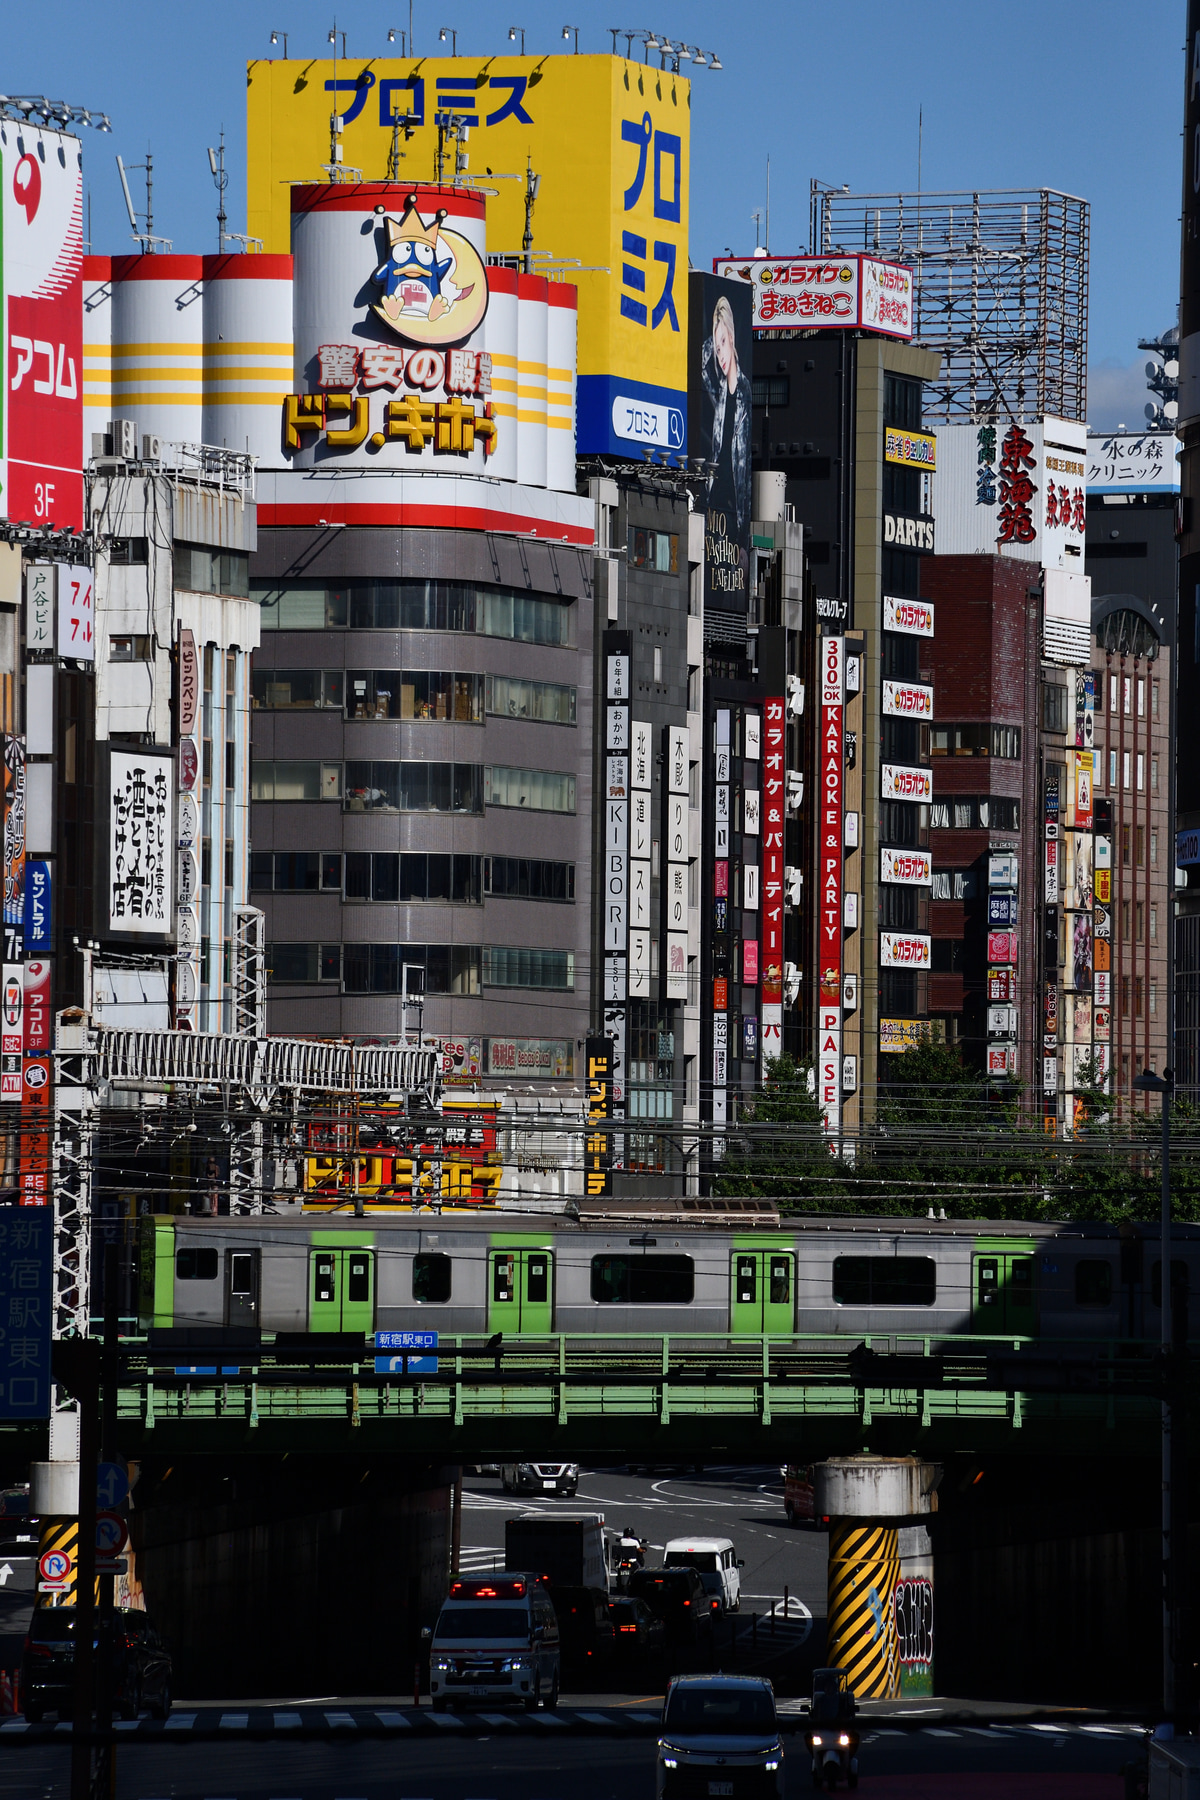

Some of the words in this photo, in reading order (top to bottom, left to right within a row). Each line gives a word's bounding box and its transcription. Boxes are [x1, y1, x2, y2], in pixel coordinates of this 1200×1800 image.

[324, 70, 535, 127] プロミス
[772, 264, 840, 285] カラオケ
[882, 271, 905, 293] カラオケ
[759, 287, 853, 322] まねきねこ
[877, 294, 909, 326] まねきねこ
[10, 335, 77, 400] アコム
[317, 345, 492, 395] 驚安の殿堂
[625, 407, 659, 439] プロミス
[1106, 439, 1163, 461] 水の森
[996, 424, 1038, 544] 東海苑
[1087, 463, 1163, 482] クリニック
[34, 484, 55, 517] 3F
[1045, 478, 1086, 534] 東海苑
[706, 507, 727, 537] MIO
[884, 515, 935, 549] DARTS
[705, 535, 740, 566] YASHIRO
[32, 573, 49, 641] 戸谷ビル
[900, 604, 927, 630] カラオケ
[614, 659, 622, 696] 6年4組
[827, 641, 838, 685] 300
[824, 684, 841, 692] People
[824, 691, 840, 701] OK
[900, 687, 926, 713] カラオケ
[613, 711, 622, 745] おかか
[825, 707, 839, 824] KARAOKE
[899, 771, 925, 796] カラオケ
[765, 703, 783, 948] カラオケ&パーティー
[825, 834, 837, 847] &
[610, 805, 623, 945] KIBORI
[898, 855, 924, 879] カラオケ
[32, 871, 45, 940] セントラル
[824, 859, 838, 941] PARTY
[897, 939, 924, 963] カラオケ
[30, 994, 43, 1035] アコム
[717, 1016, 727, 1045] ZEST
[4, 1036, 21, 1052] たばこ
[30, 1038, 42, 1047] 3F
[3, 1076, 21, 1092] ATM
[8, 1218, 43, 1407] 新宿駅東口
[378, 1333, 433, 1345] 新宿駅東口
